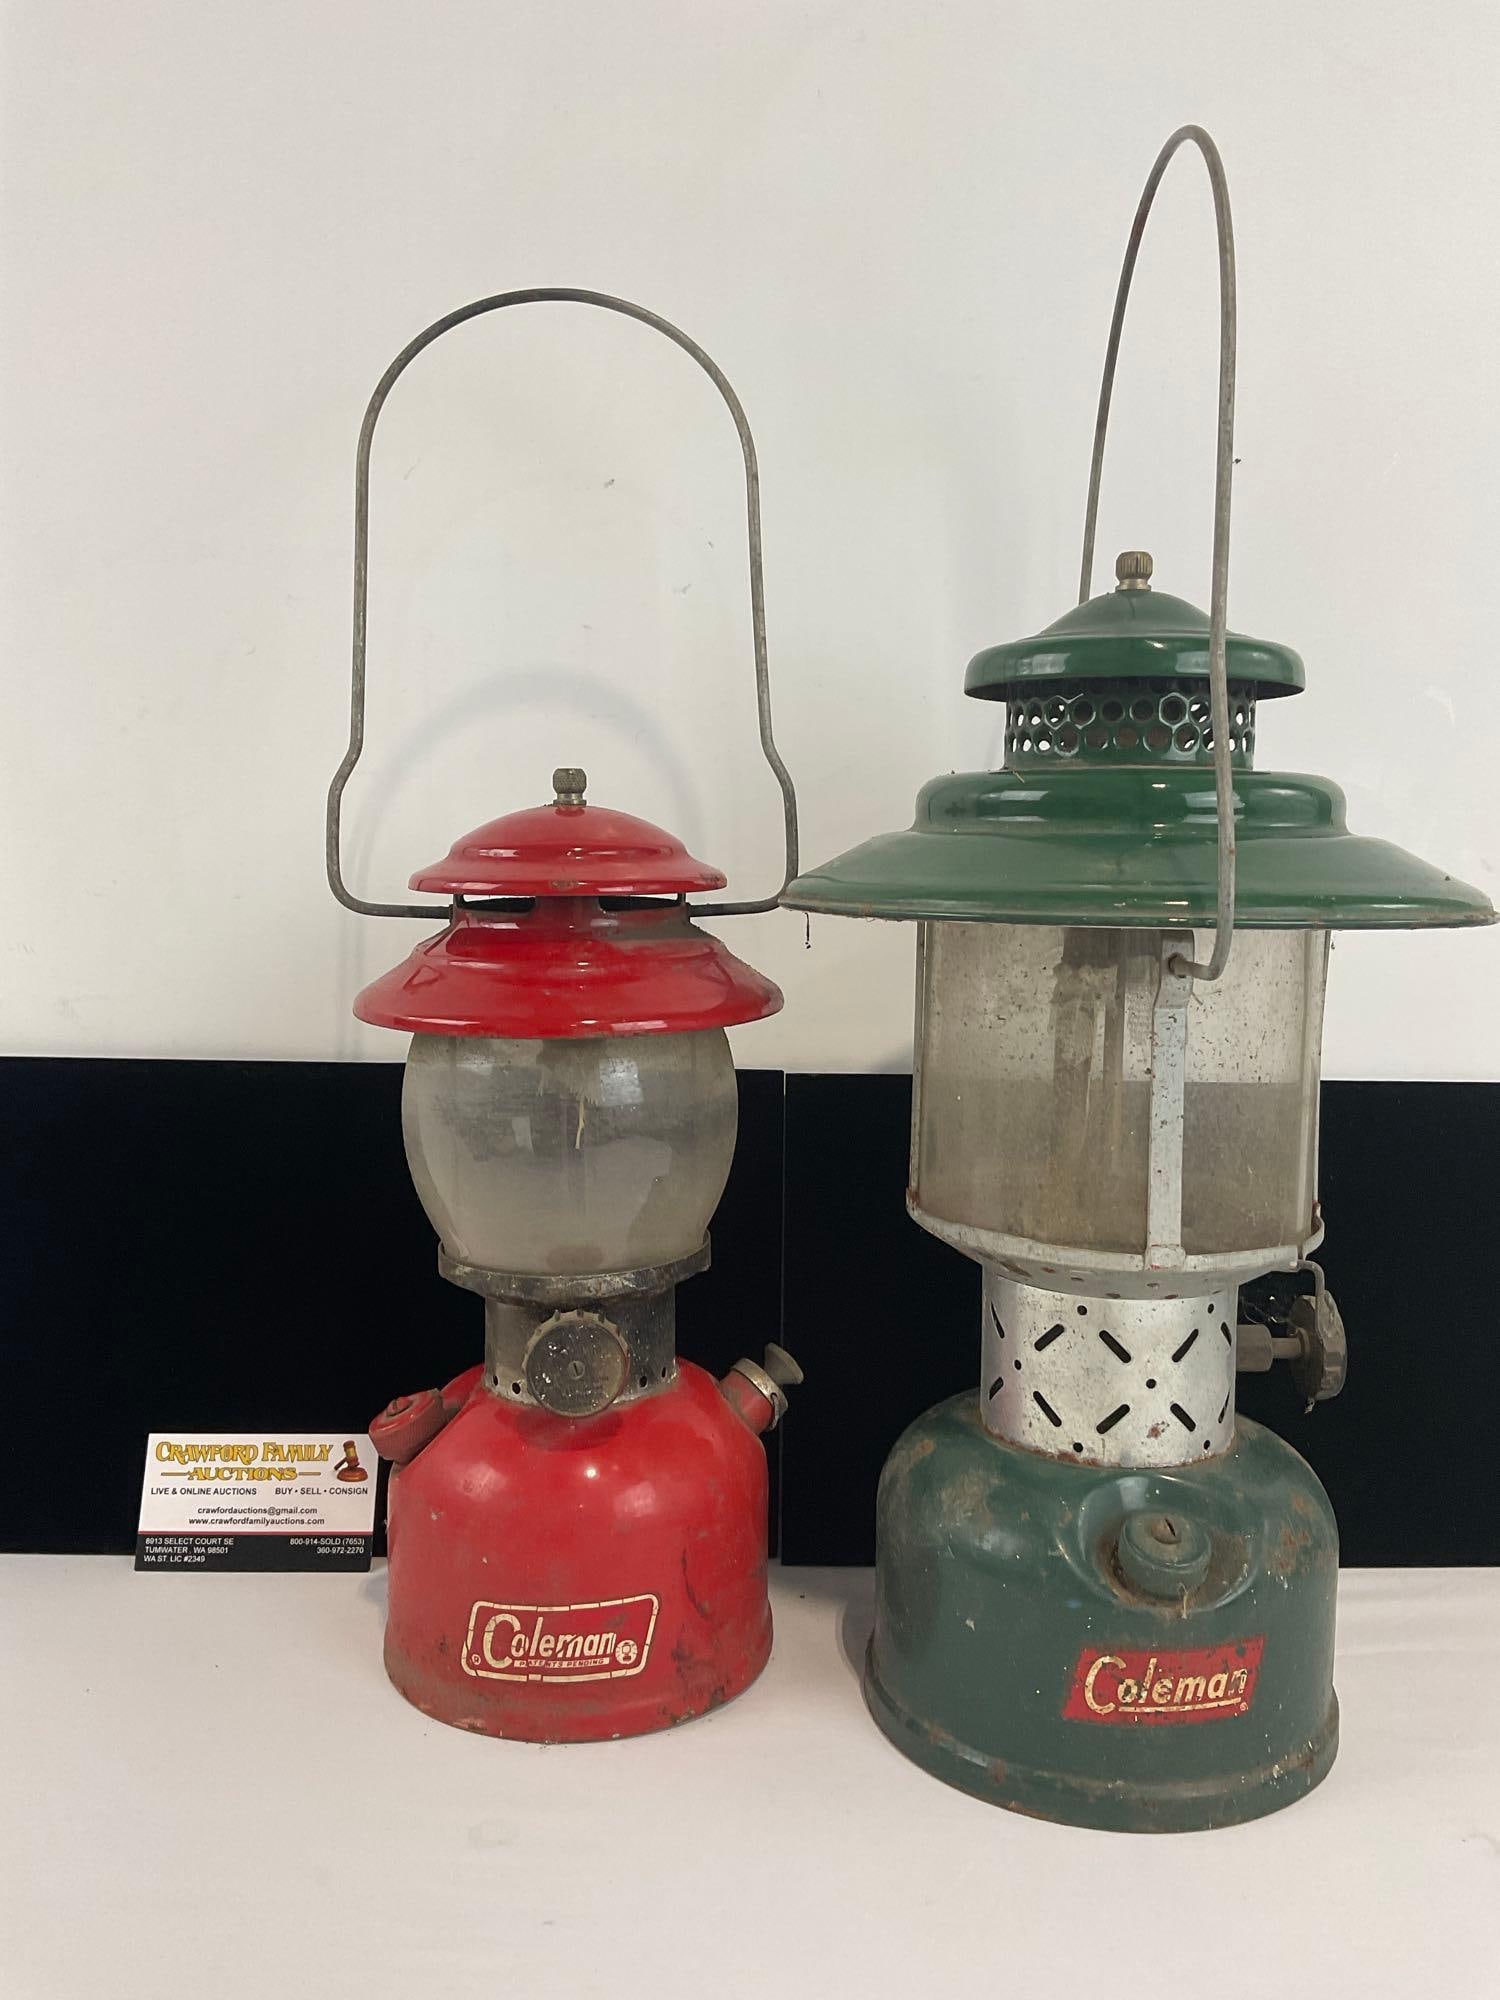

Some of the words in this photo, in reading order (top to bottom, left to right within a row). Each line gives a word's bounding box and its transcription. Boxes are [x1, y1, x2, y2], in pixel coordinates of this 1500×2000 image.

[155, 1441, 258, 1465] CRAWFORD
[261, 1441, 334, 1463] FAMILY
[188, 1467, 298, 1481] AUCTIONS
[151, 1487, 169, 1495] LIVE
[171, 1487, 177, 1495] &
[180, 1487, 211, 1495] ONLINE
[213, 1487, 257, 1495] AUCTIONS
[275, 1487, 293, 1495] BUY
[300, 1487, 322, 1495] SELL
[329, 1487, 368, 1495] CONSIGN
[197, 1506, 318, 1516] crawfordauctions@gmail.com
[188, 1517, 325, 1526] www.crawfordfamilyauctions.com
[145, 1537, 163, 1545] 8913
[164, 1537, 193, 1545] SELECT
[194, 1537, 222, 1545] COURT
[223, 1537, 234, 1545] SE
[290, 1537, 341, 1545] 800-914-SOLD
[342, 1537, 365, 1546] (7653)
[193, 1546, 206, 1554] WA
[207, 1546, 229, 1554] 98501
[316, 1546, 365, 1554] 360-972-2270
[143, 1555, 156, 1563] WA
[157, 1555, 167, 1563] ST
[170, 1555, 182, 1563] LIC
[183, 1555, 206, 1563] #2349
[483, 1613, 617, 1669] Coleman
[566, 1658, 606, 1667] PENDING
[1084, 1655, 1248, 1715] Coleman
